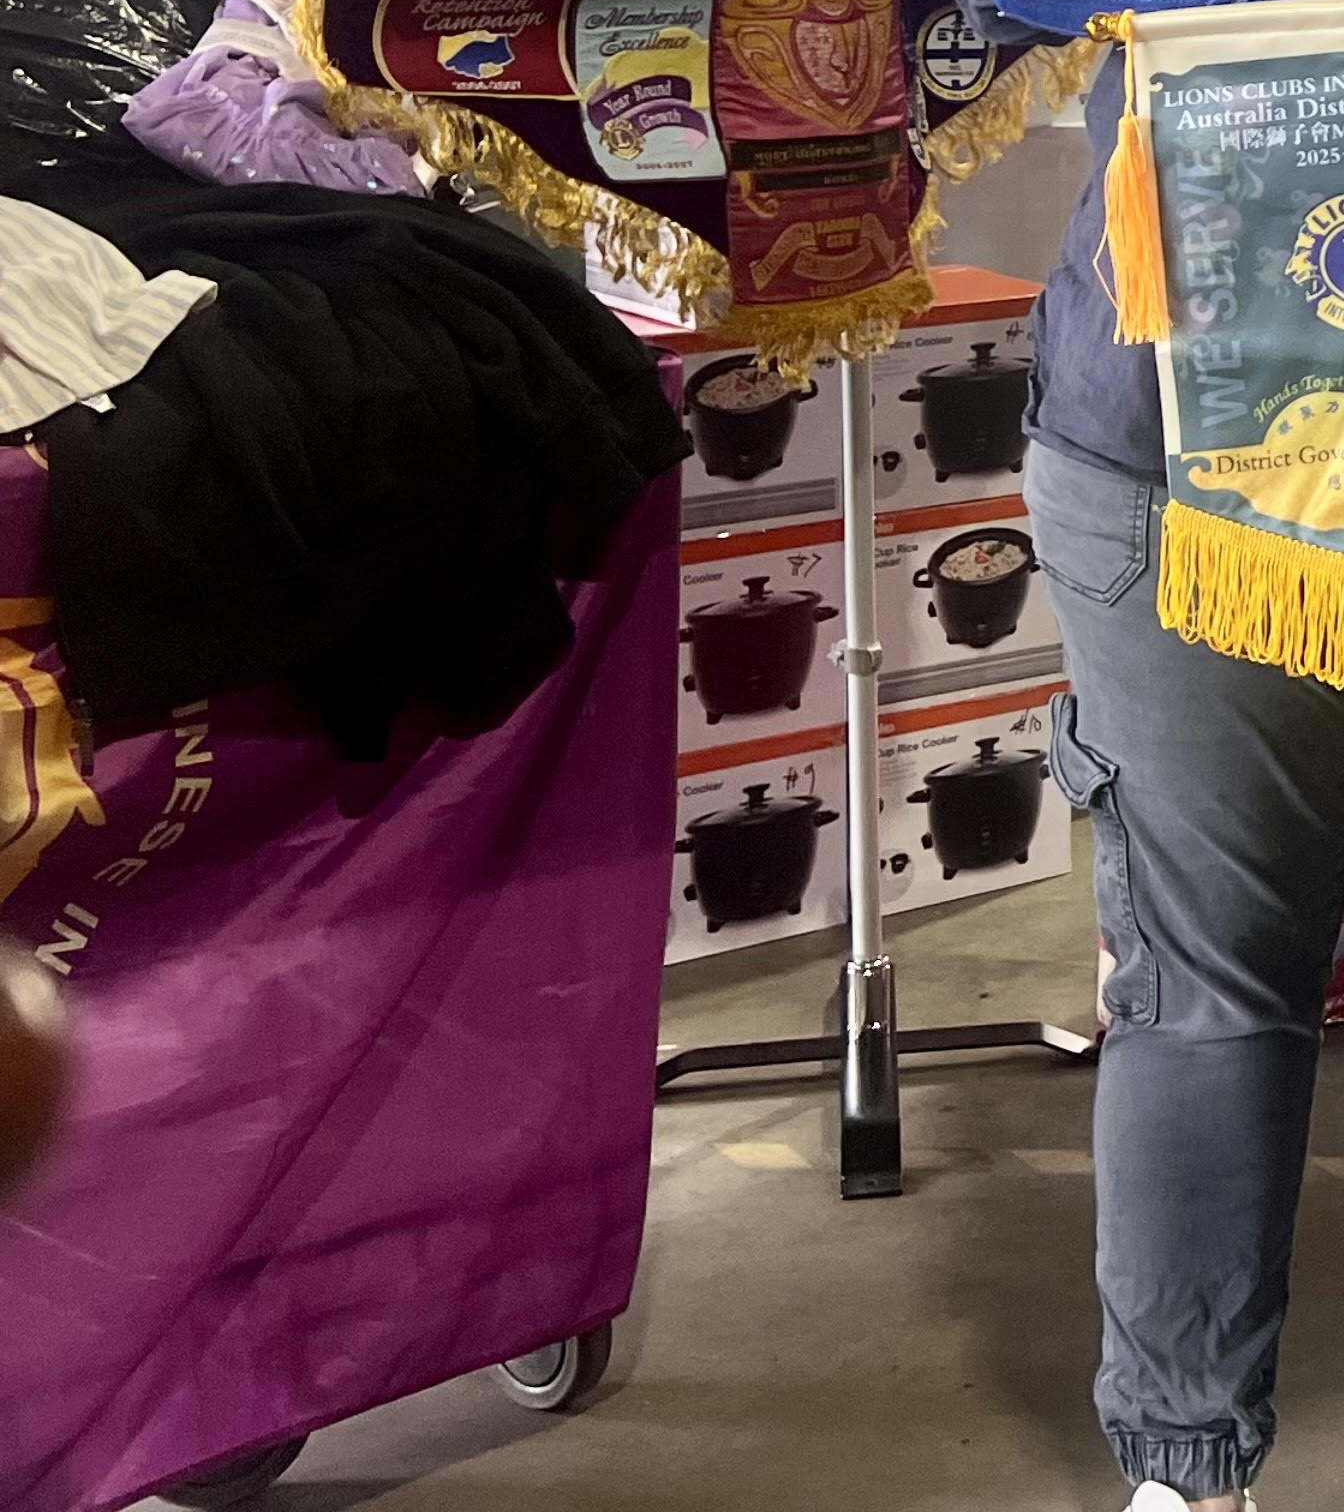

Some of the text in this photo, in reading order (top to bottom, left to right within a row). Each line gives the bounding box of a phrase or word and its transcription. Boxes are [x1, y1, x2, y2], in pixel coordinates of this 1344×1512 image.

[422, 12, 548, 37] Campaign
[585, 6, 705, 30] Membership
[599, 31, 691, 57] Excellence
[603, 94, 629, 114] Year
[1164, 86, 1234, 108] LIONS
[1241, 77, 1316, 100] CLUBS
[1176, 105, 1287, 131] Australia
[1194, 339, 1248, 428] WE
[1253, 382, 1298, 424] Hands
[1215, 454, 1292, 475] District
[683, 572, 723, 585] Cooker
[783, 763, 816, 795] #9
